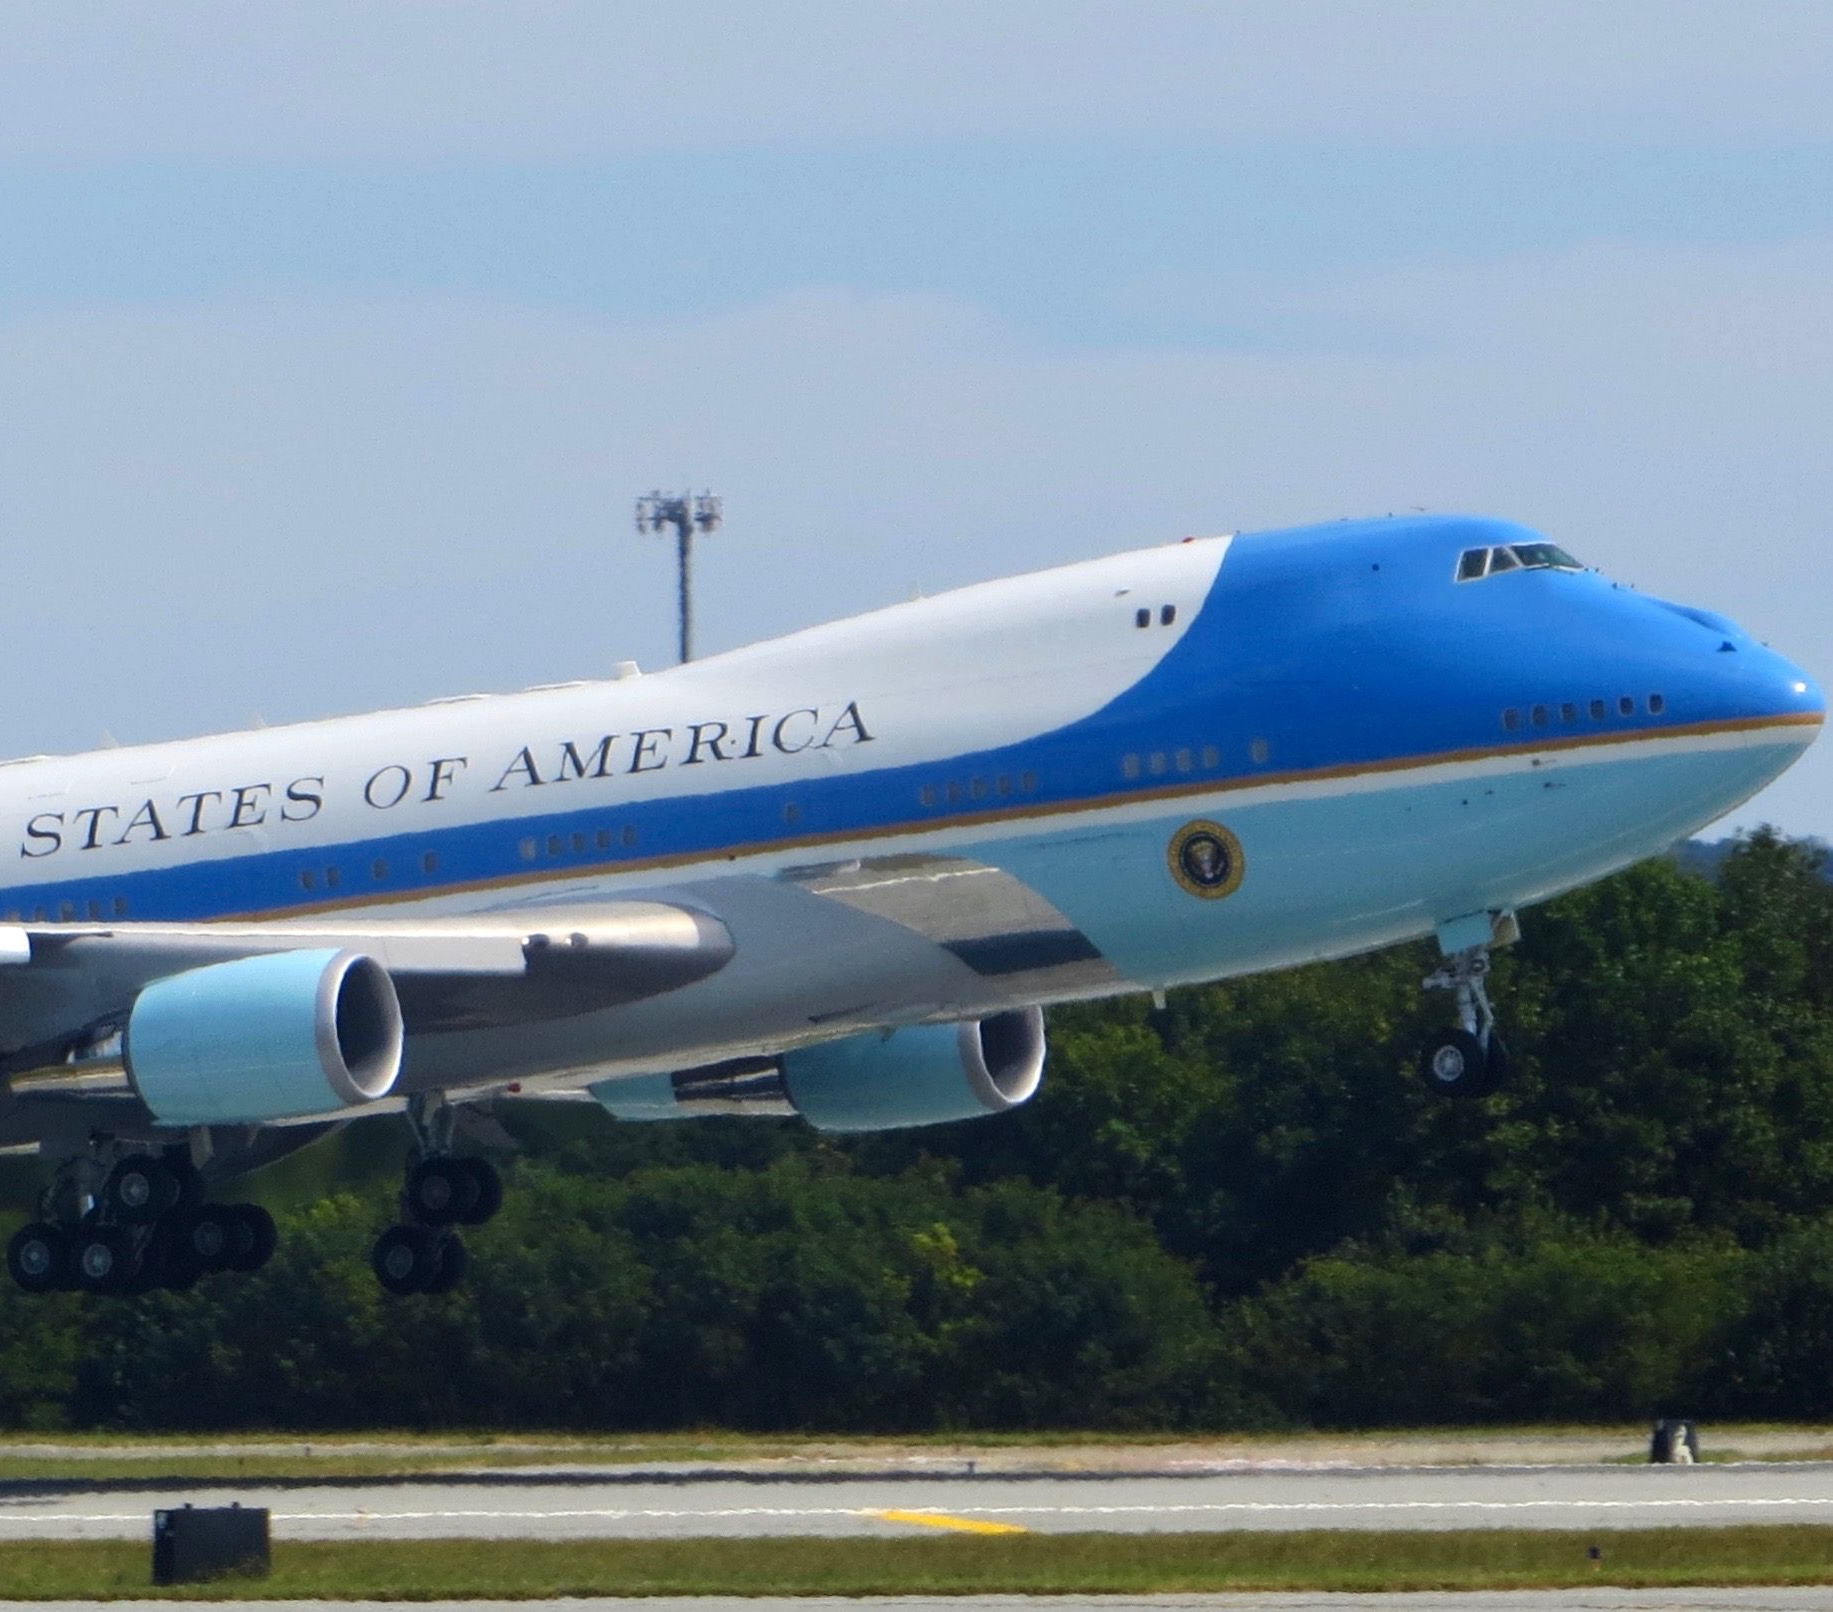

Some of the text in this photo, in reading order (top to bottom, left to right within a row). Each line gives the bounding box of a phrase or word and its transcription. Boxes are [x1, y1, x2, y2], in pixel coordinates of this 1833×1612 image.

[19, 776, 326, 858] STATES
[364, 757, 468, 810] OF
[488, 700, 877, 793] AMERICA
